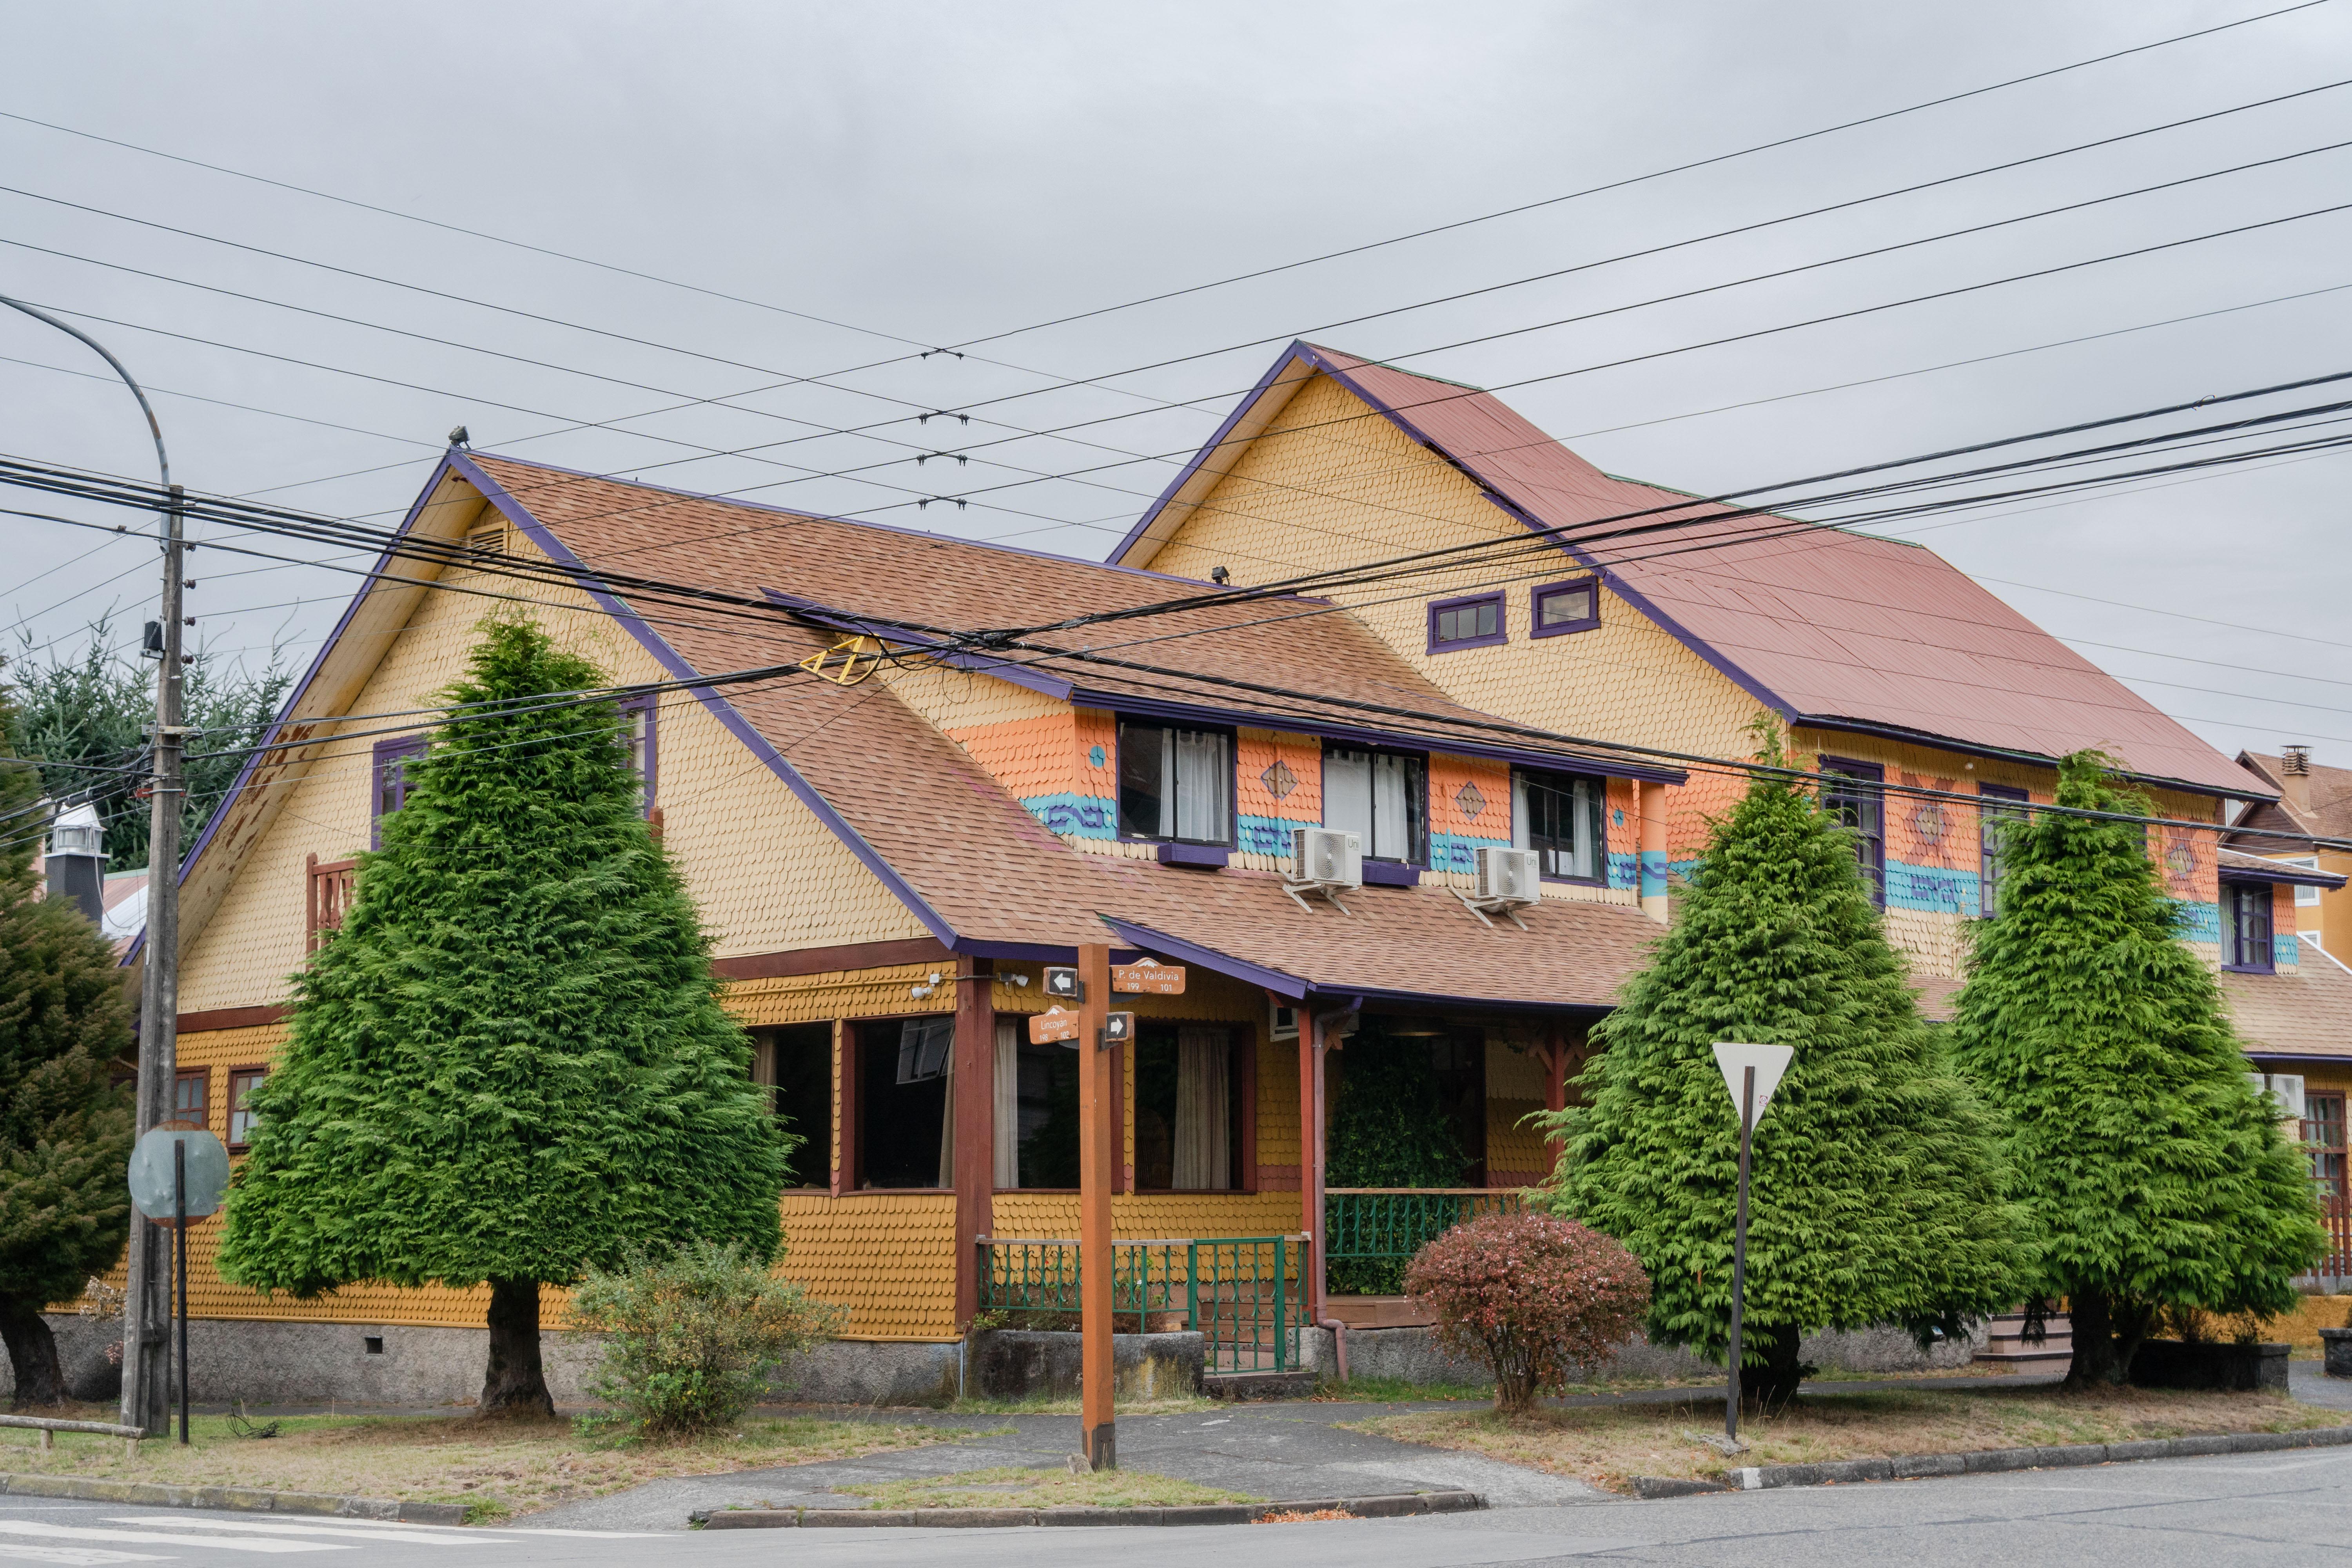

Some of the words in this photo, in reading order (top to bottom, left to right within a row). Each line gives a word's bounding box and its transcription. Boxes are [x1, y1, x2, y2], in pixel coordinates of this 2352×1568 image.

[1348, 839, 1359, 848] Uni
[1527, 857, 1537, 866] Uni
[1119, 969, 1126, 979] P.
[1129, 970, 1141, 979] de
[1143, 970, 1179, 980] Valdivia
[1127, 982, 1140, 991] 199
[1041, 1017, 1067, 1031] Lincoyán
[1039, 1033, 1048, 1042] 198
[1060, 1031, 1070, 1039] 102
